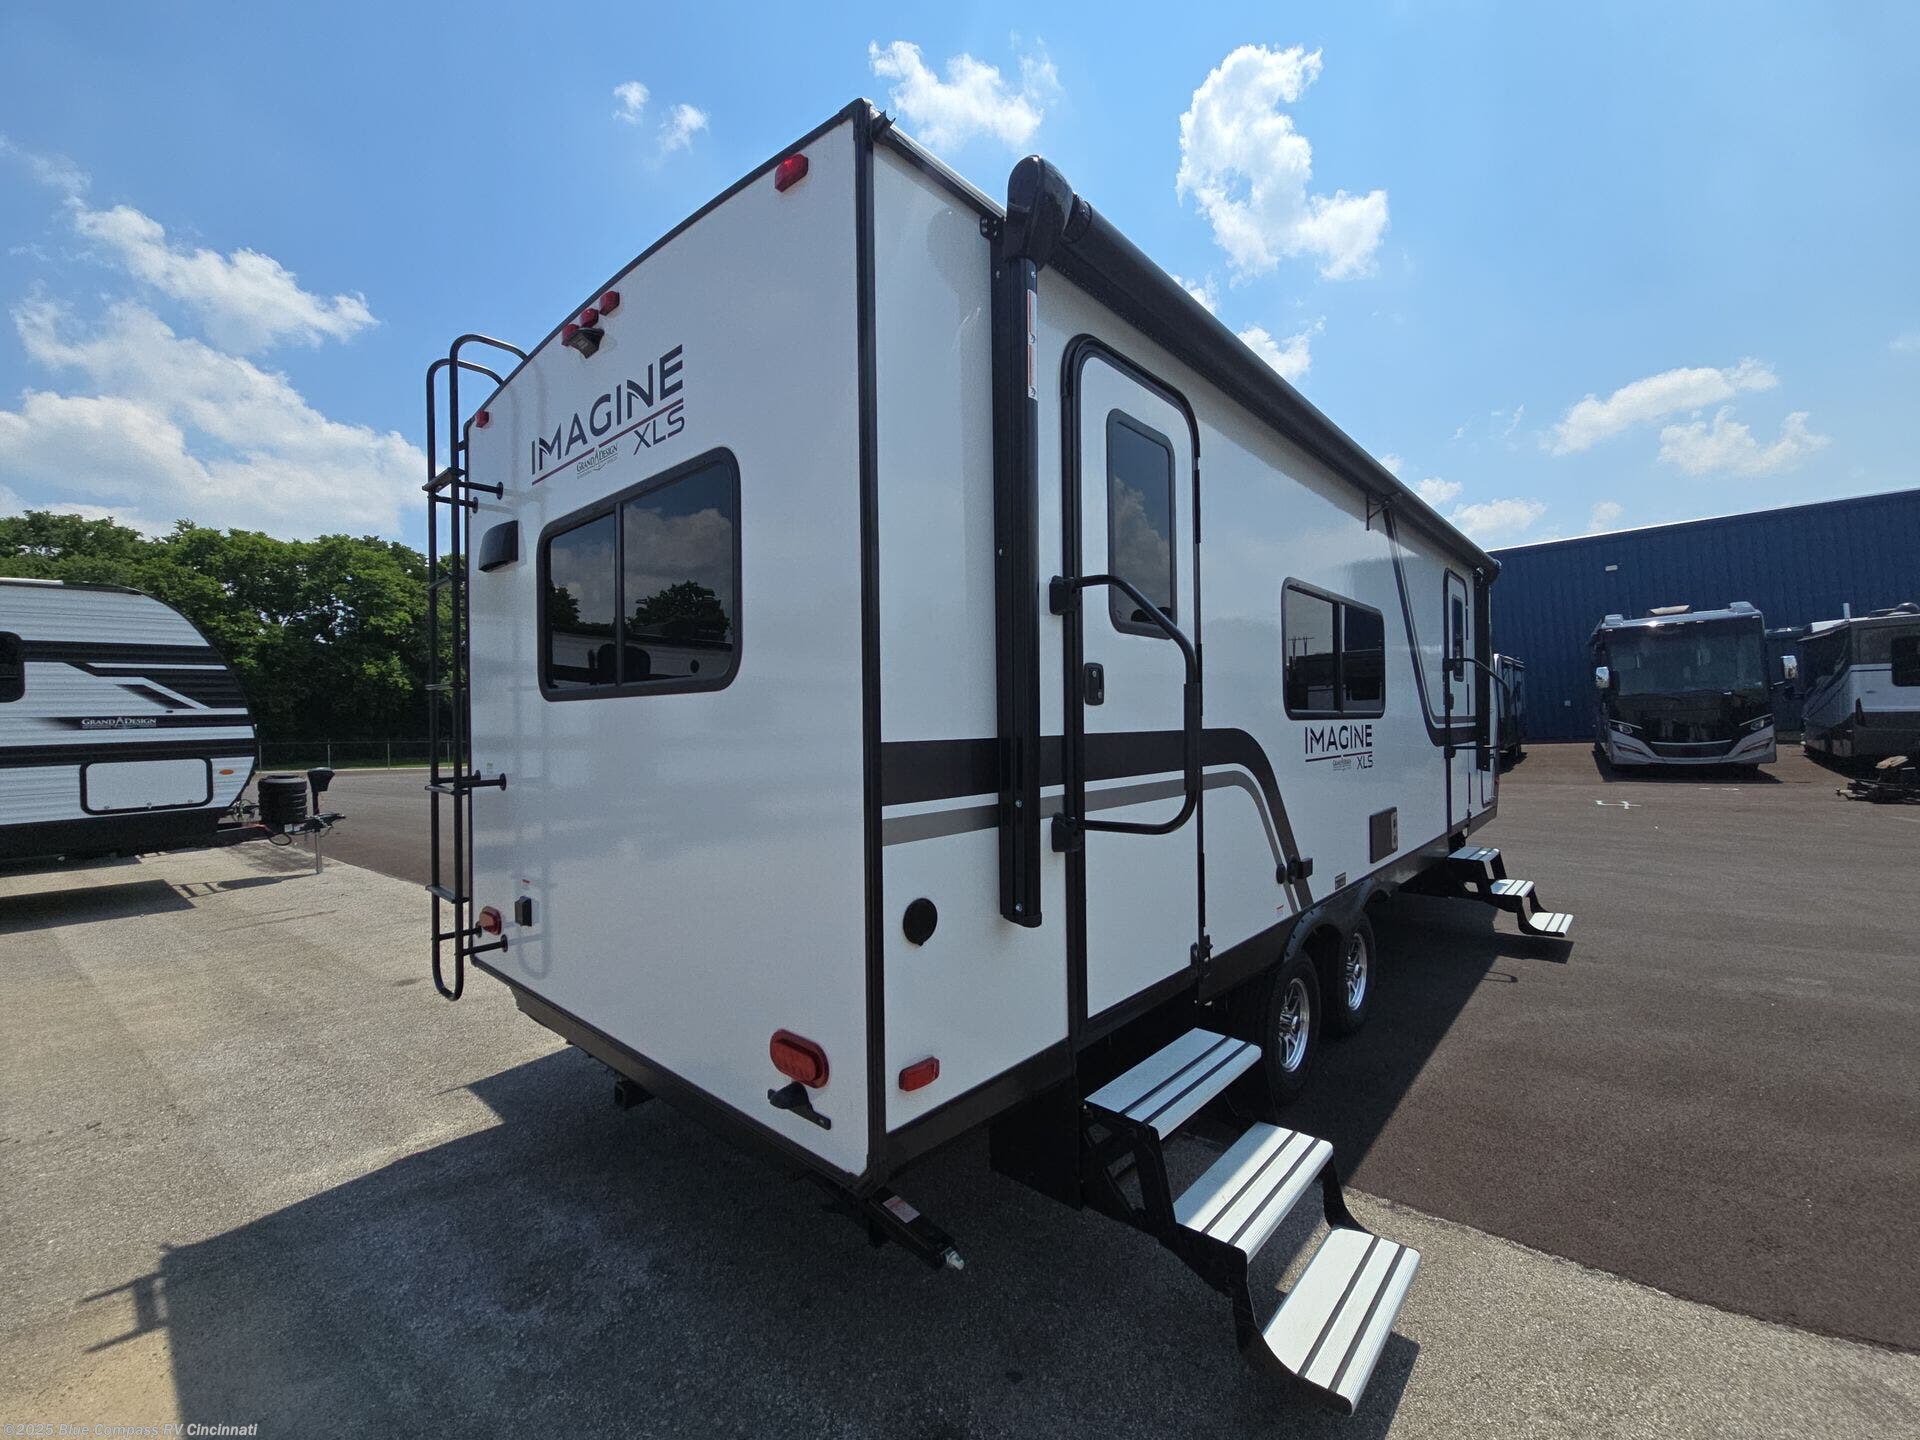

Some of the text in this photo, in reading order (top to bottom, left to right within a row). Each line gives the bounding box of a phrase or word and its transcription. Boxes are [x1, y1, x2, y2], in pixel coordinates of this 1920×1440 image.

[532, 344, 683, 475] IMAGINE
[634, 405, 685, 455] XLS
[1305, 724, 1372, 754] IMAGINE
[1356, 754, 1373, 769] XLS
